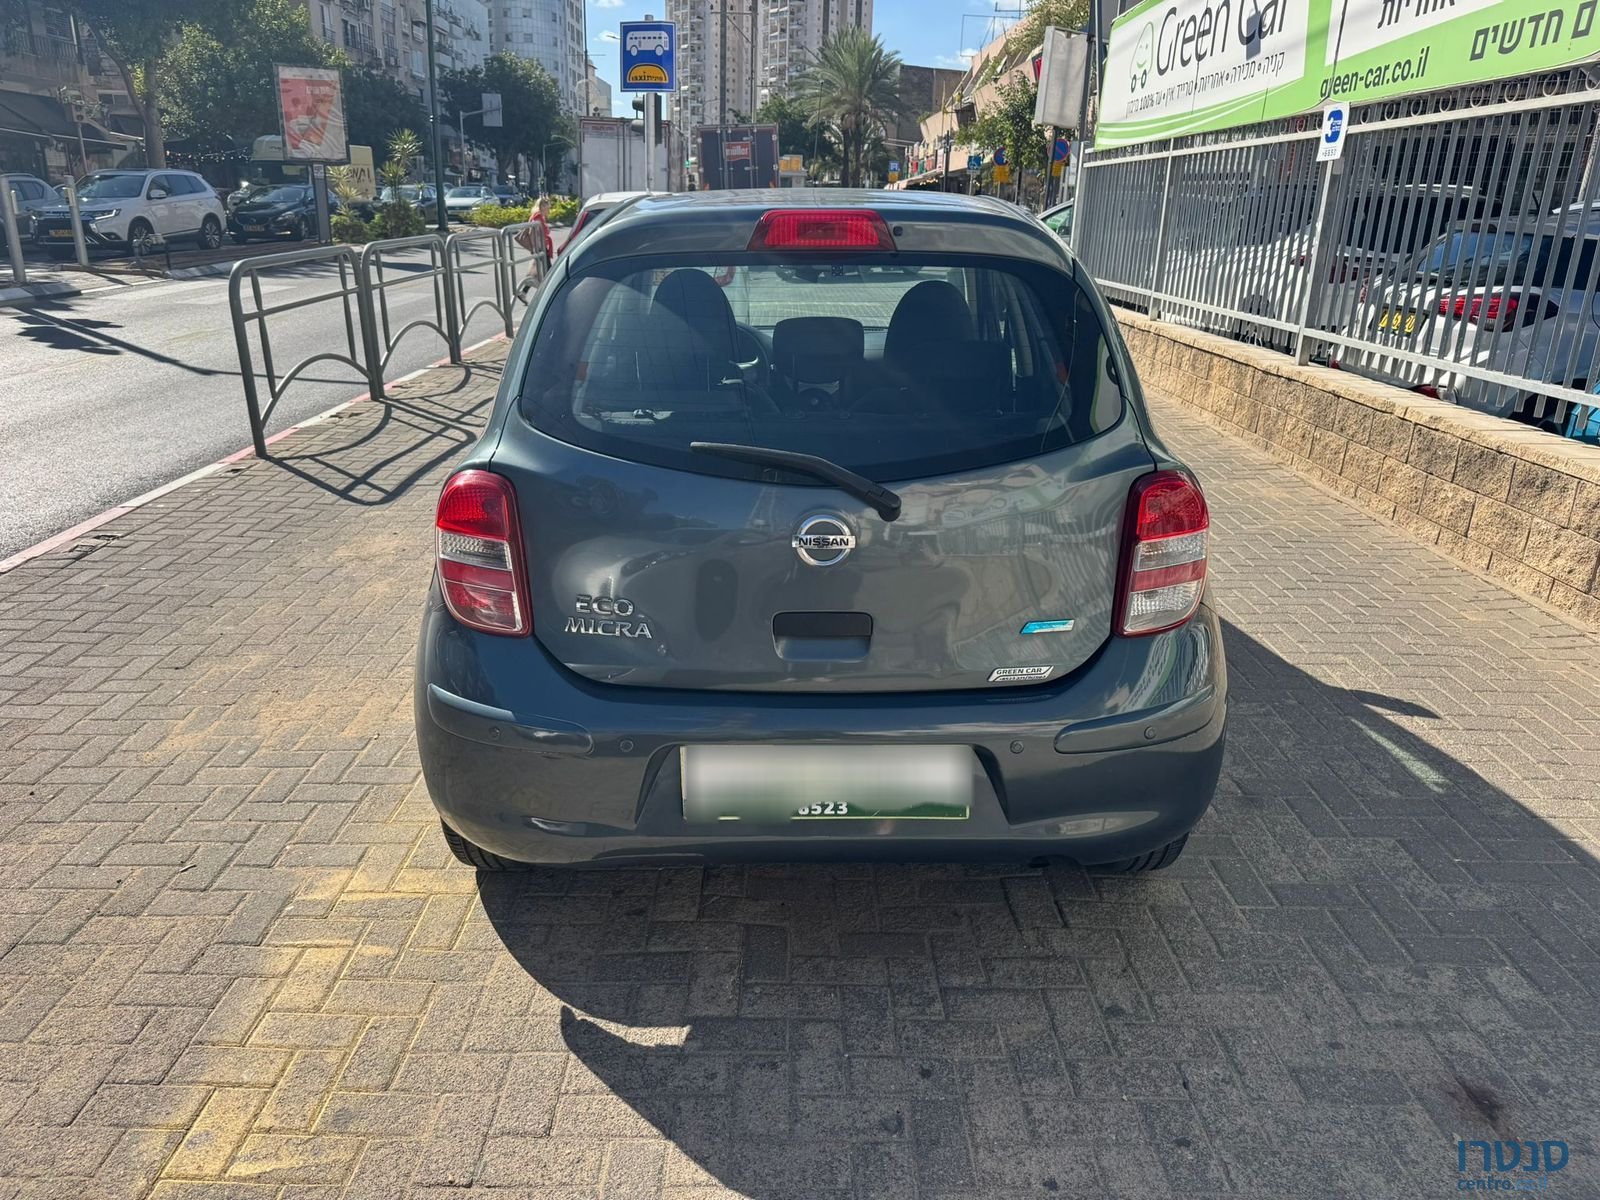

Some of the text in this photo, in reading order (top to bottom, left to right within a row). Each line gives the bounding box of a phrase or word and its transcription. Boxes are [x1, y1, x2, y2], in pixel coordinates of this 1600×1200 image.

[1157, 0, 1230, 76] Green
[1469, 9, 1564, 62] חדשים
[1230, 61, 1256, 84] מכירה
[1262, 52, 1285, 77] קניה
[1198, 70, 1225, 94] אחריות
[1139, 93, 1154, 111] 100%
[799, 536, 849, 547] NISSAN
[575, 594, 634, 616] ECO
[564, 617, 653, 640] MICRA
